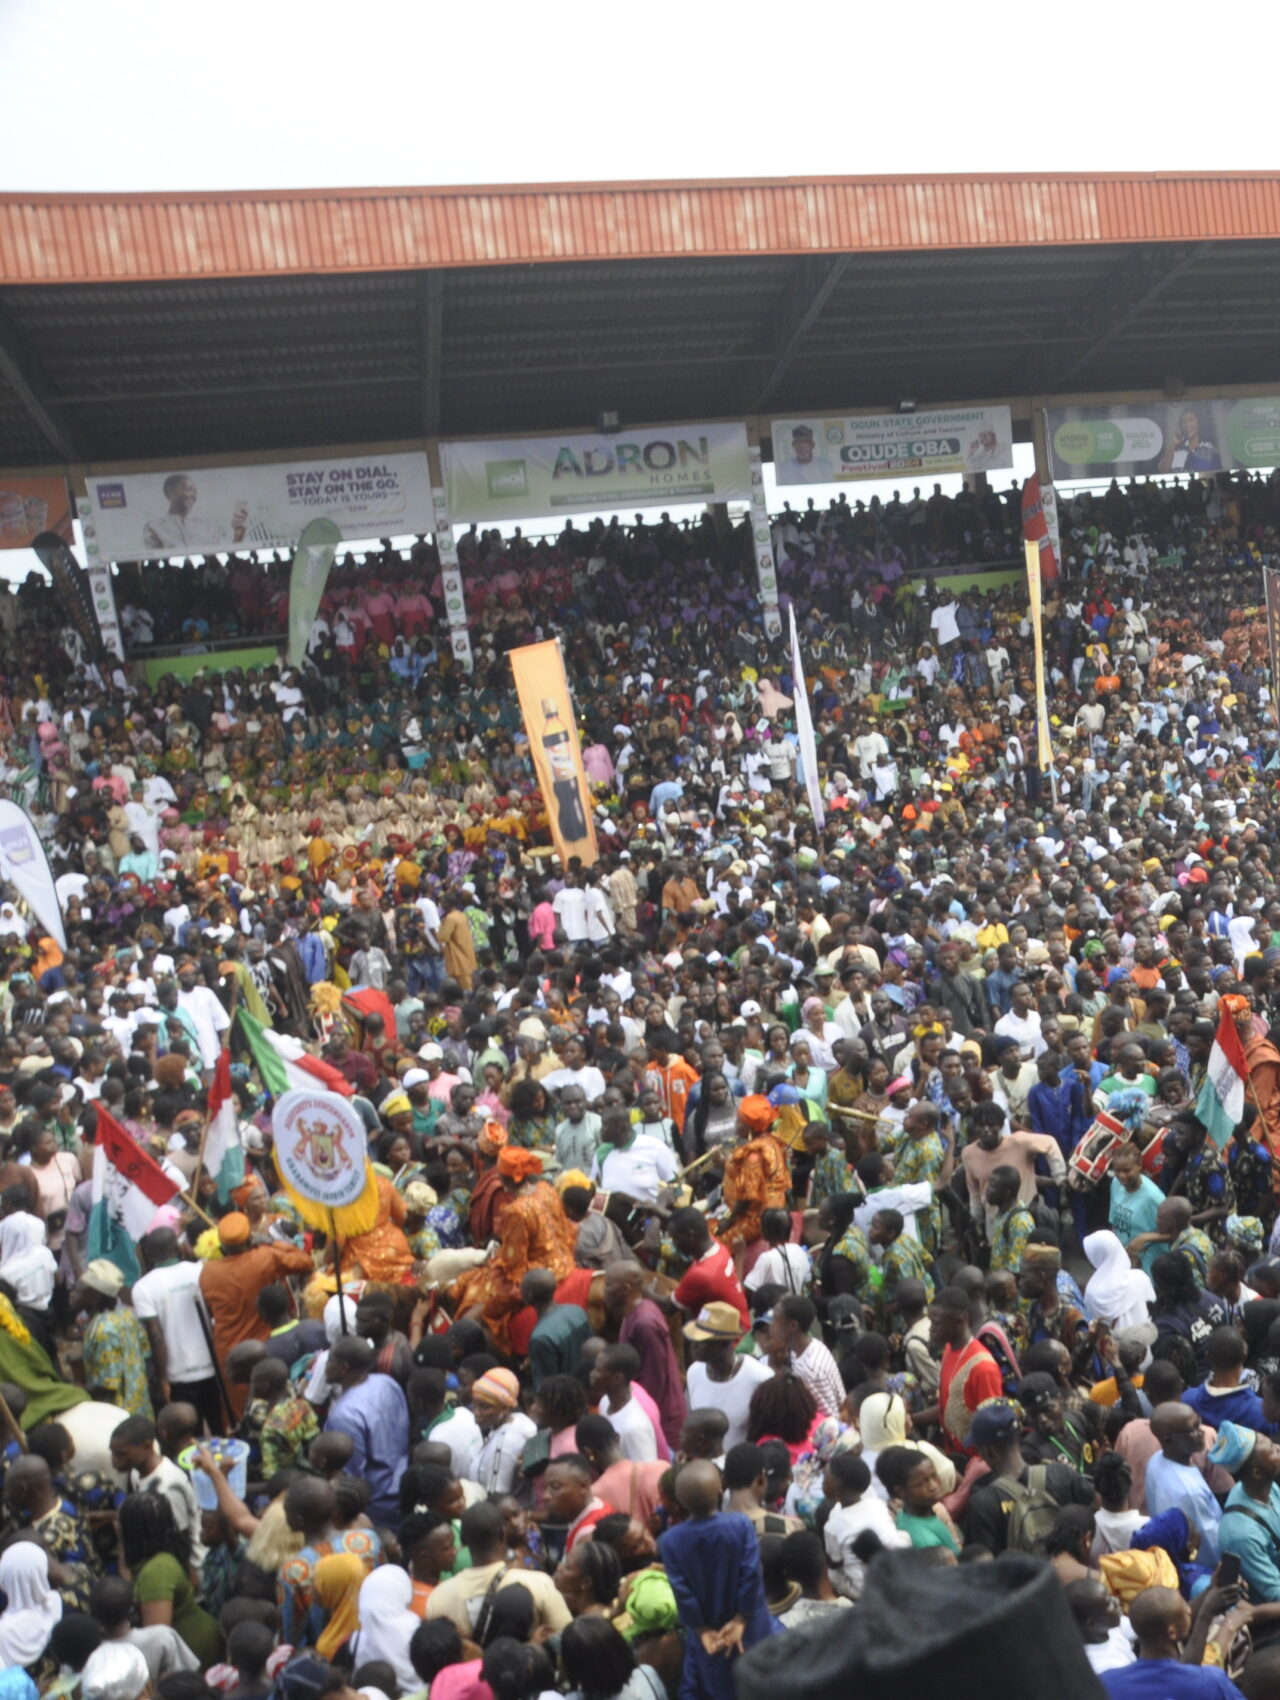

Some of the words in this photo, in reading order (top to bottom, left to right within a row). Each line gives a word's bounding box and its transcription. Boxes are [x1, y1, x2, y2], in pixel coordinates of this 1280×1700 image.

[851, 420, 880, 430] OGUN
[882, 417, 913, 428] STATE
[915, 411, 985, 425] GOVERNMENT
[552, 437, 709, 480] ADRON
[847, 443, 910, 461] OJUDE
[911, 440, 952, 457] OBA
[286, 471, 325, 485] STAY
[329, 469, 353, 481] ON
[355, 465, 397, 479] DIAL,
[841, 460, 889, 472] Festival
[650, 470, 711, 484] HOMES
[288, 486, 320, 497] STAY
[324, 483, 345, 494] ON
[348, 480, 374, 492] THE
[303, 495, 338, 506] TODAY
[341, 494, 351, 503] IS
[354, 491, 388, 502] YOURS
